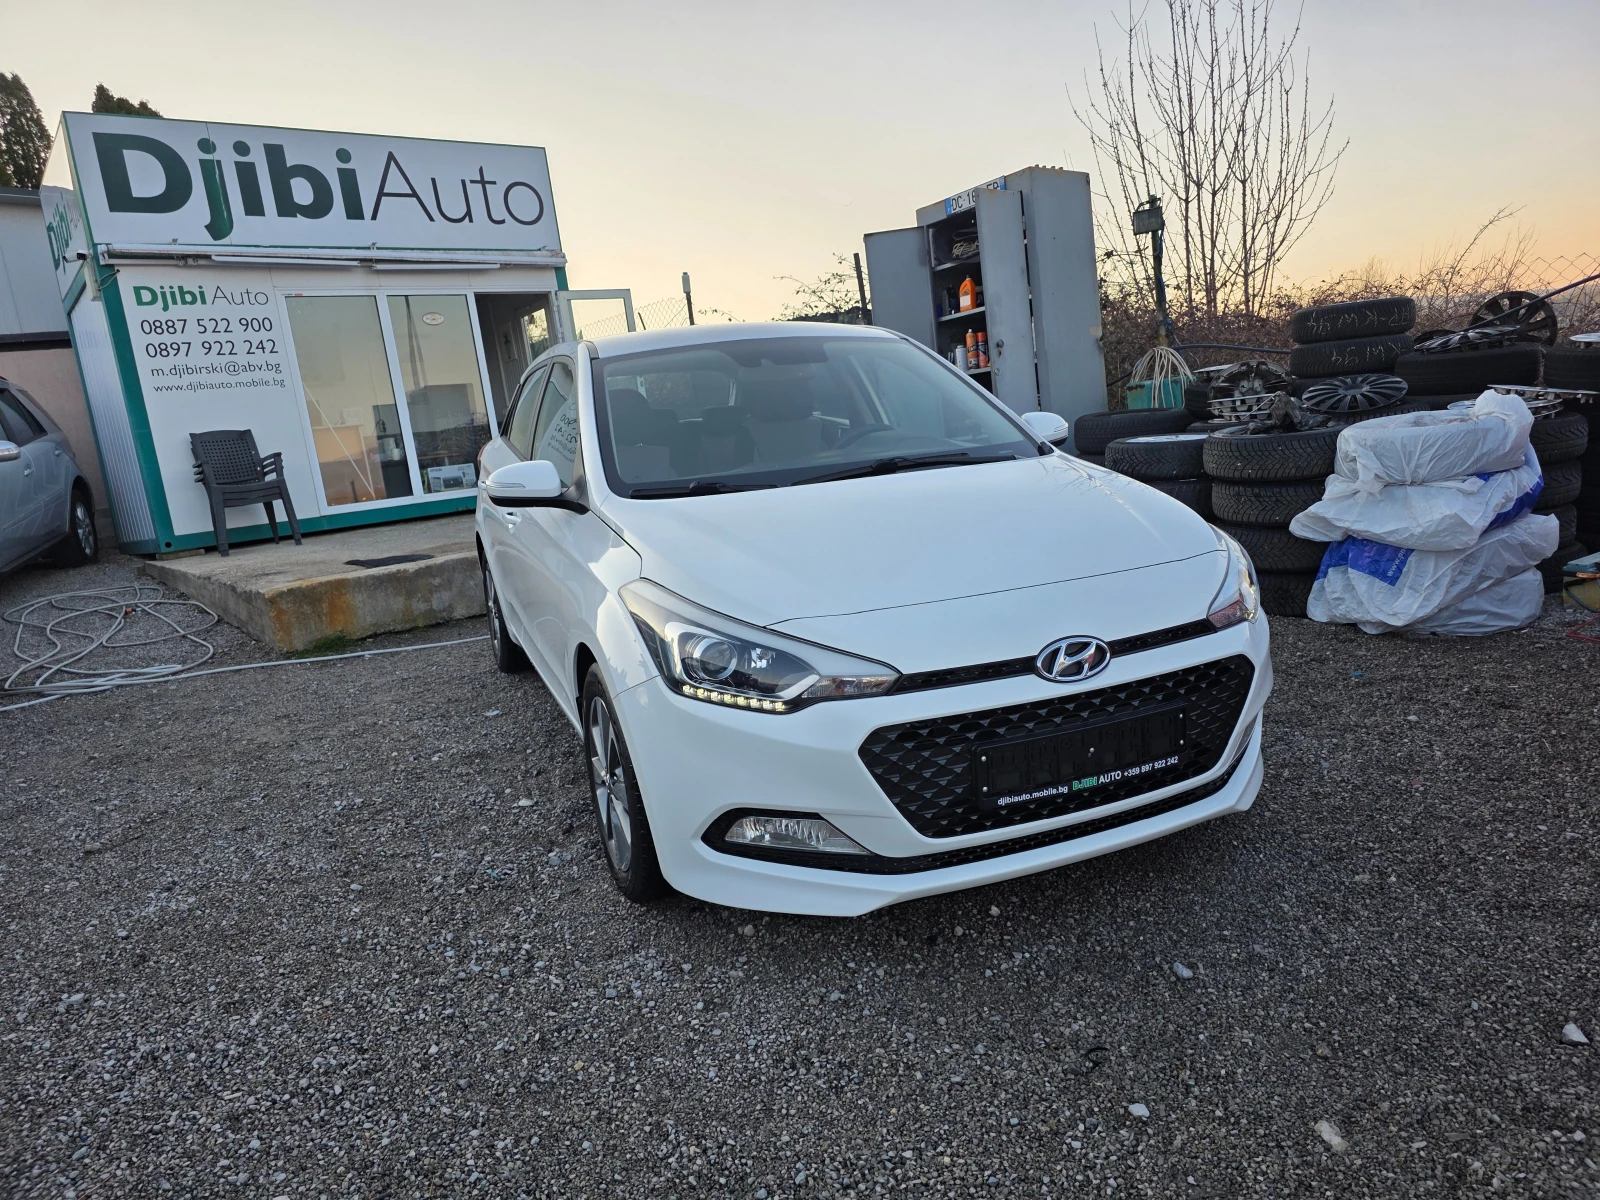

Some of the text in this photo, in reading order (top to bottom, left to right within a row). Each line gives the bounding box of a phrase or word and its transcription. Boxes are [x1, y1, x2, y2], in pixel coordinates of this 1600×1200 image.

[133, 285, 269, 313] Djibi Auto
[140, 316, 273, 335] 0887 522 900
[145, 338, 279, 358] 0897 922 242
[151, 360, 282, 379] m.djibirski@abv.bg
[153, 377, 286, 393] www.djibiauto.mobile.bg
[997, 755, 1179, 806] djibiauto.mobile.bg DJIBI AUTO +359 897 922 242
